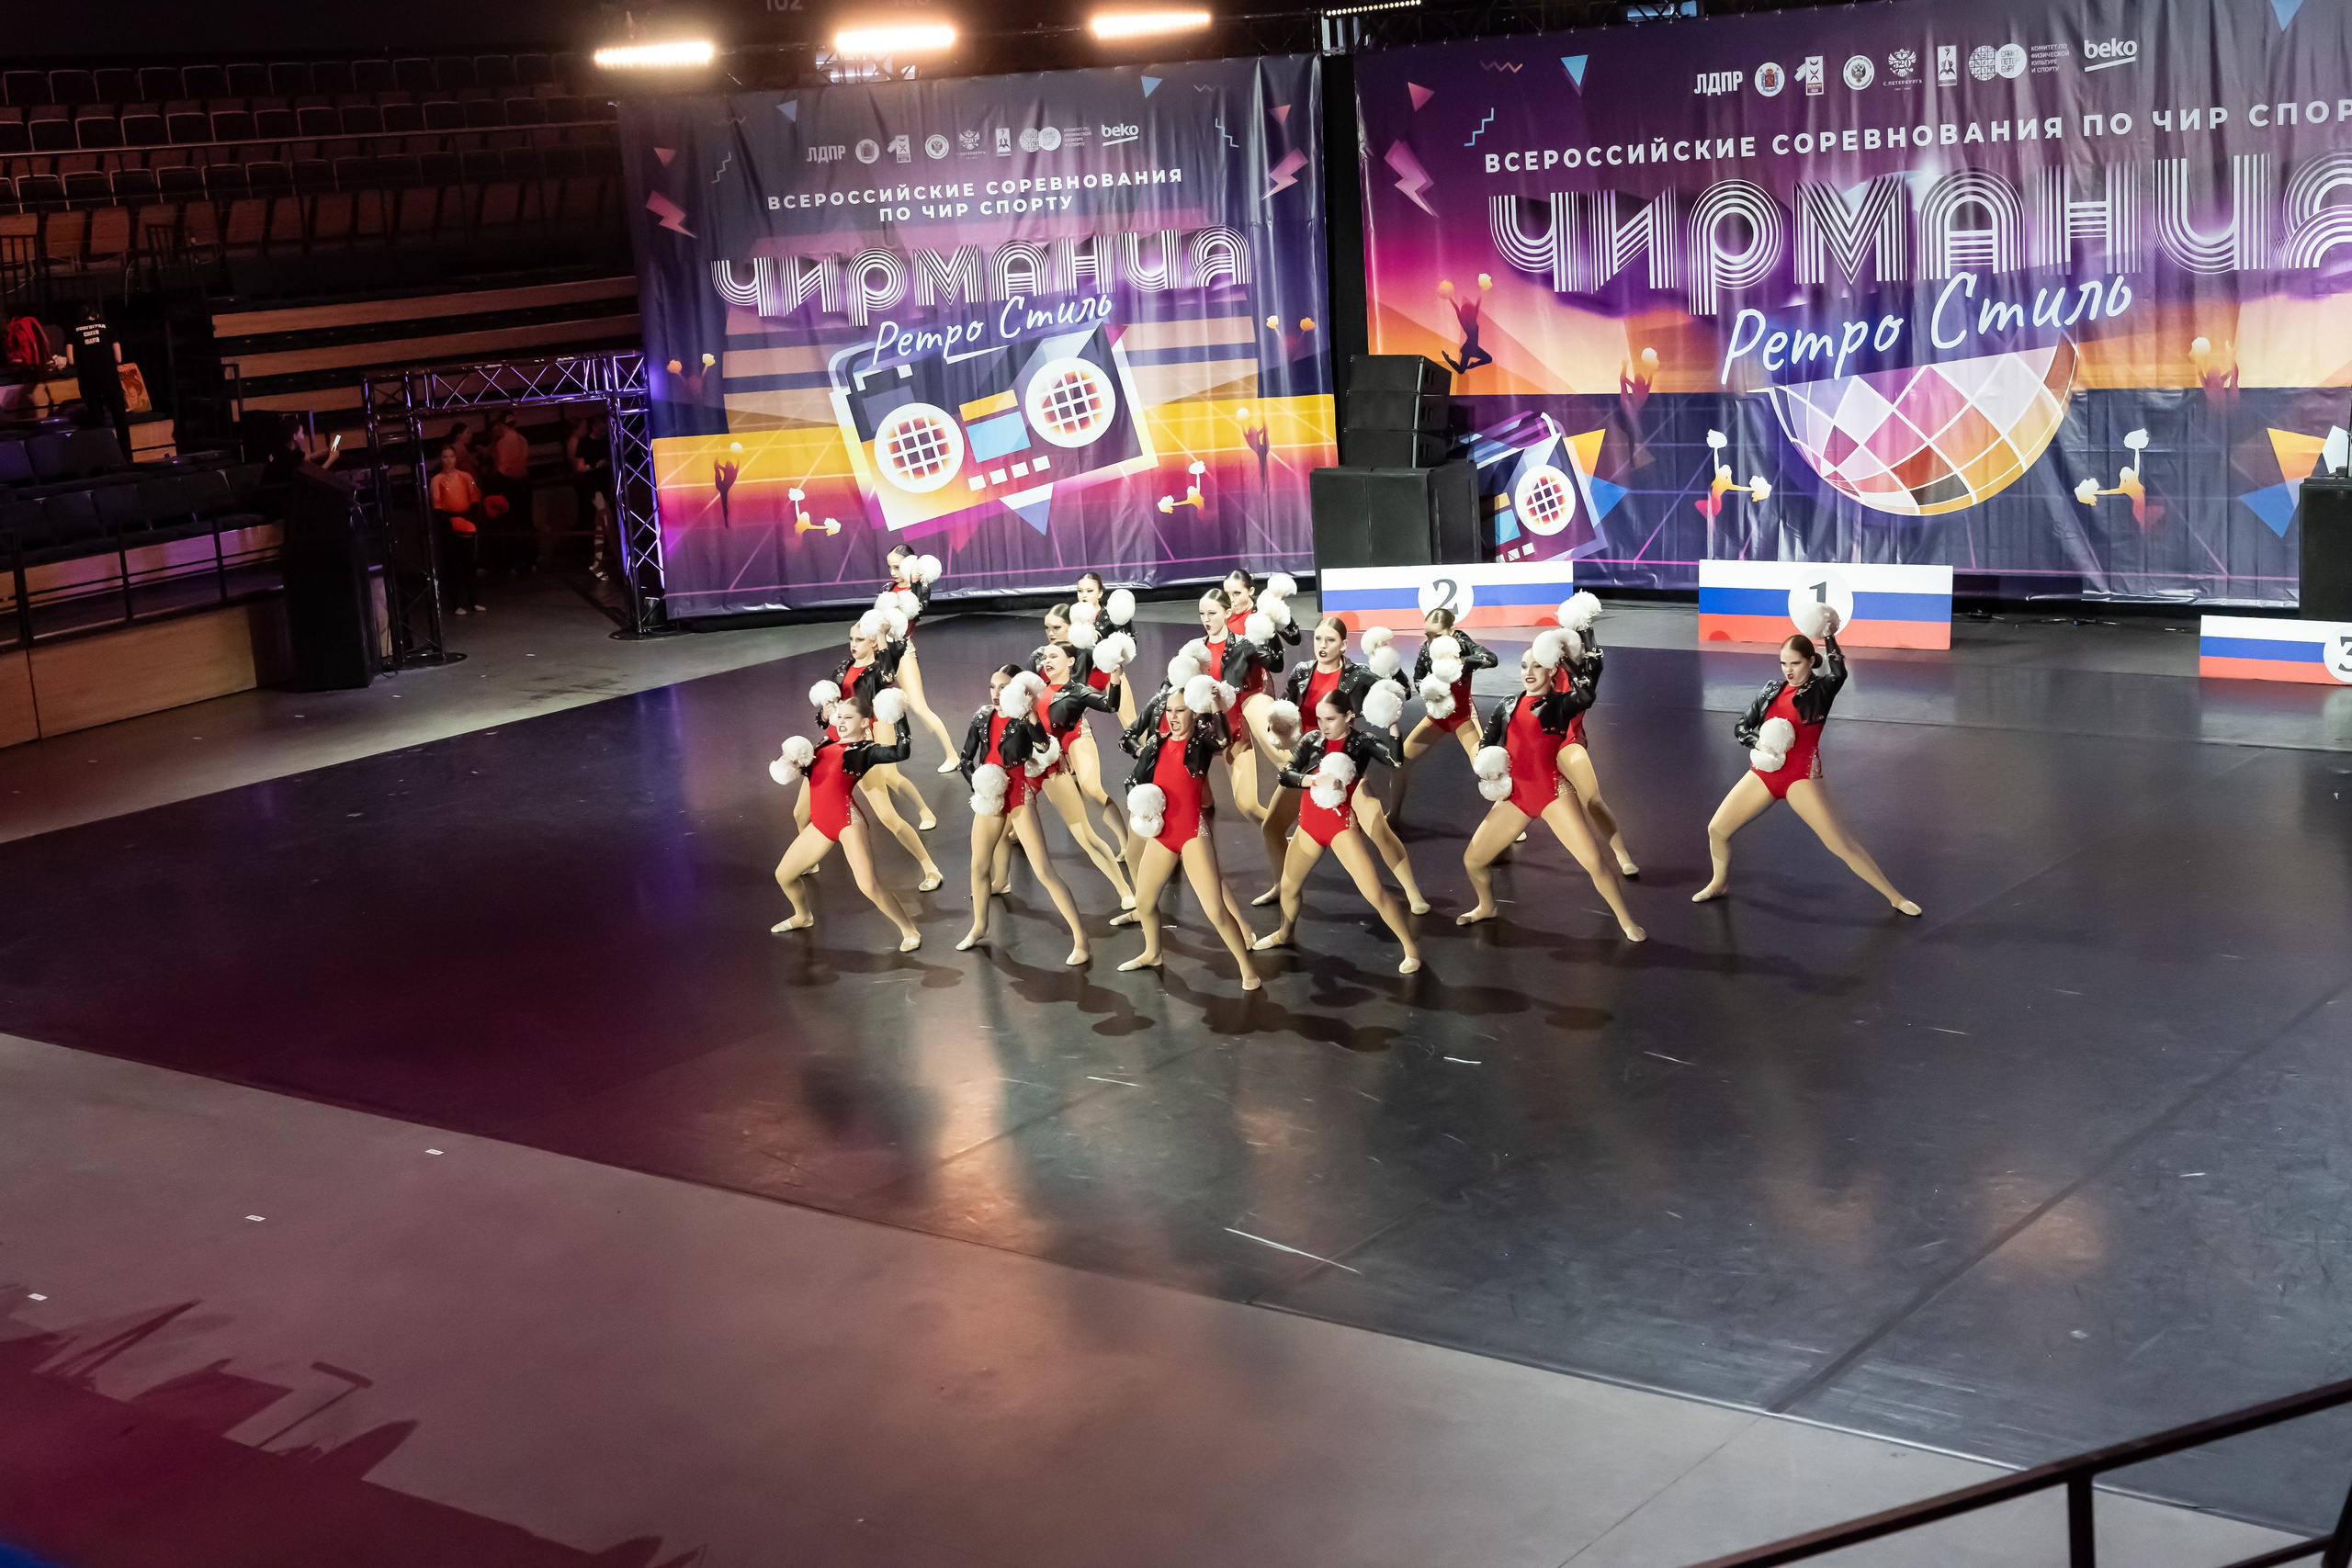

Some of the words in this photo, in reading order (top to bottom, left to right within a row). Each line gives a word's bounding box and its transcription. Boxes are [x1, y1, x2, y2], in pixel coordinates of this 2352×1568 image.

[2084, 38, 2138, 60] beko
[1694, 71, 1743, 96] ЛДПР
[1101, 123, 1139, 138] beko
[1485, 136, 1756, 174] ВСЕРОССИЙСКИЕ
[1772, 117, 2063, 155] СОРЕВНОВАНИЯ
[2083, 112, 2132, 137] ПО
[2153, 107, 2228, 131] ЧИР
[807, 145, 846, 164] ЛДПР
[767, 183, 975, 210] ВСЕРОССИЙСКИЕ
[986, 168, 1183, 195] СОРЕВНОВАНИЯ
[879, 206, 911, 222] ПО
[922, 202, 969, 220] ЧИР
[979, 196, 1074, 215] СПОРТУ
[872, 321, 983, 366] Ретро
[1000, 294, 1113, 339] Стиль
[1721, 306, 1902, 385] Ретро
[1930, 272, 2133, 349] Стиль
[1431, 579, 1460, 615] 2
